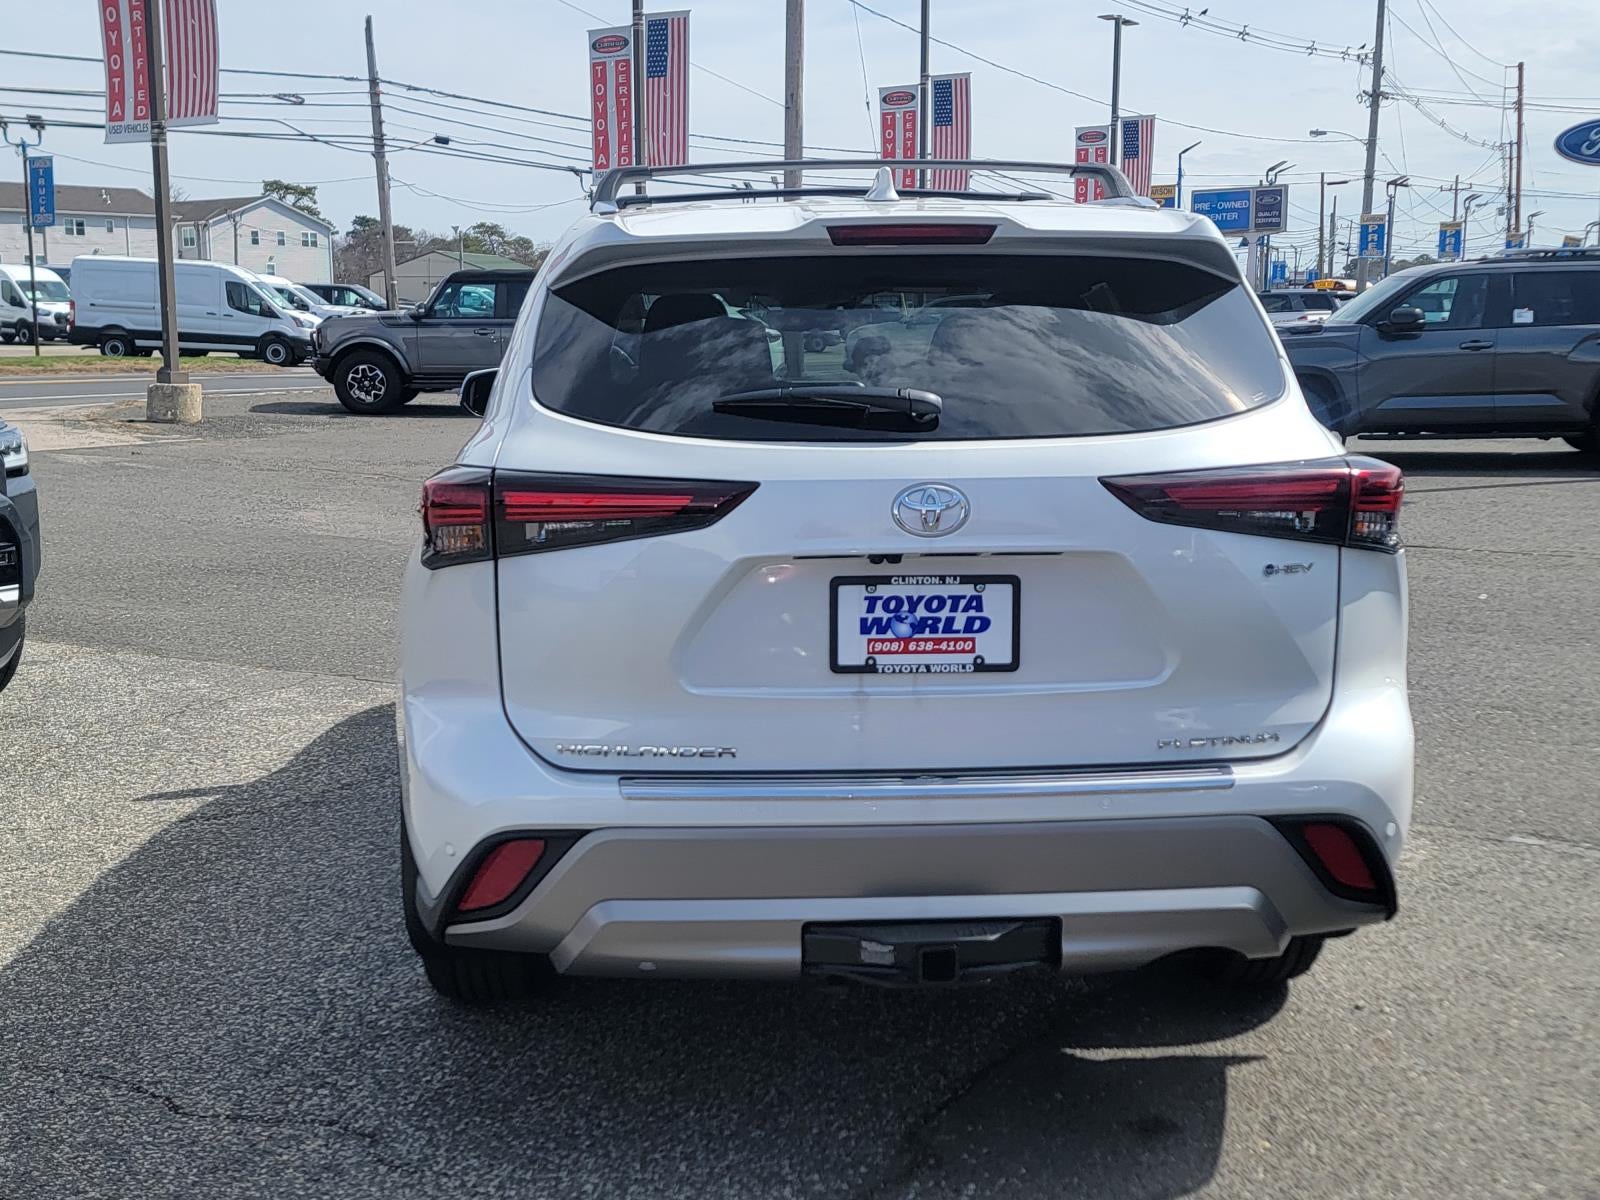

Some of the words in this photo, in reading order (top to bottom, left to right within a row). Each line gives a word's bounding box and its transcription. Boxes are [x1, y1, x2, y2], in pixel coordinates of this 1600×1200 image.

[595, 66, 607, 165] TOYOTA
[617, 62, 630, 165] CERTIFIED
[108, 124, 123, 135] USED
[123, 122, 149, 134] VEHICLES
[38, 168, 47, 213] TRUCK
[1194, 202, 1211, 211] PRE
[1217, 200, 1249, 209] OWNED
[945, 576, 960, 584] NJ
[864, 594, 984, 614] TOYOTA
[868, 640, 905, 653] (908)
[908, 640, 973, 651] 638-4100
[877, 664, 927, 673] TOYOTA
[930, 664, 975, 673] WORLD
[556, 744, 737, 758] HIGHLANDER
